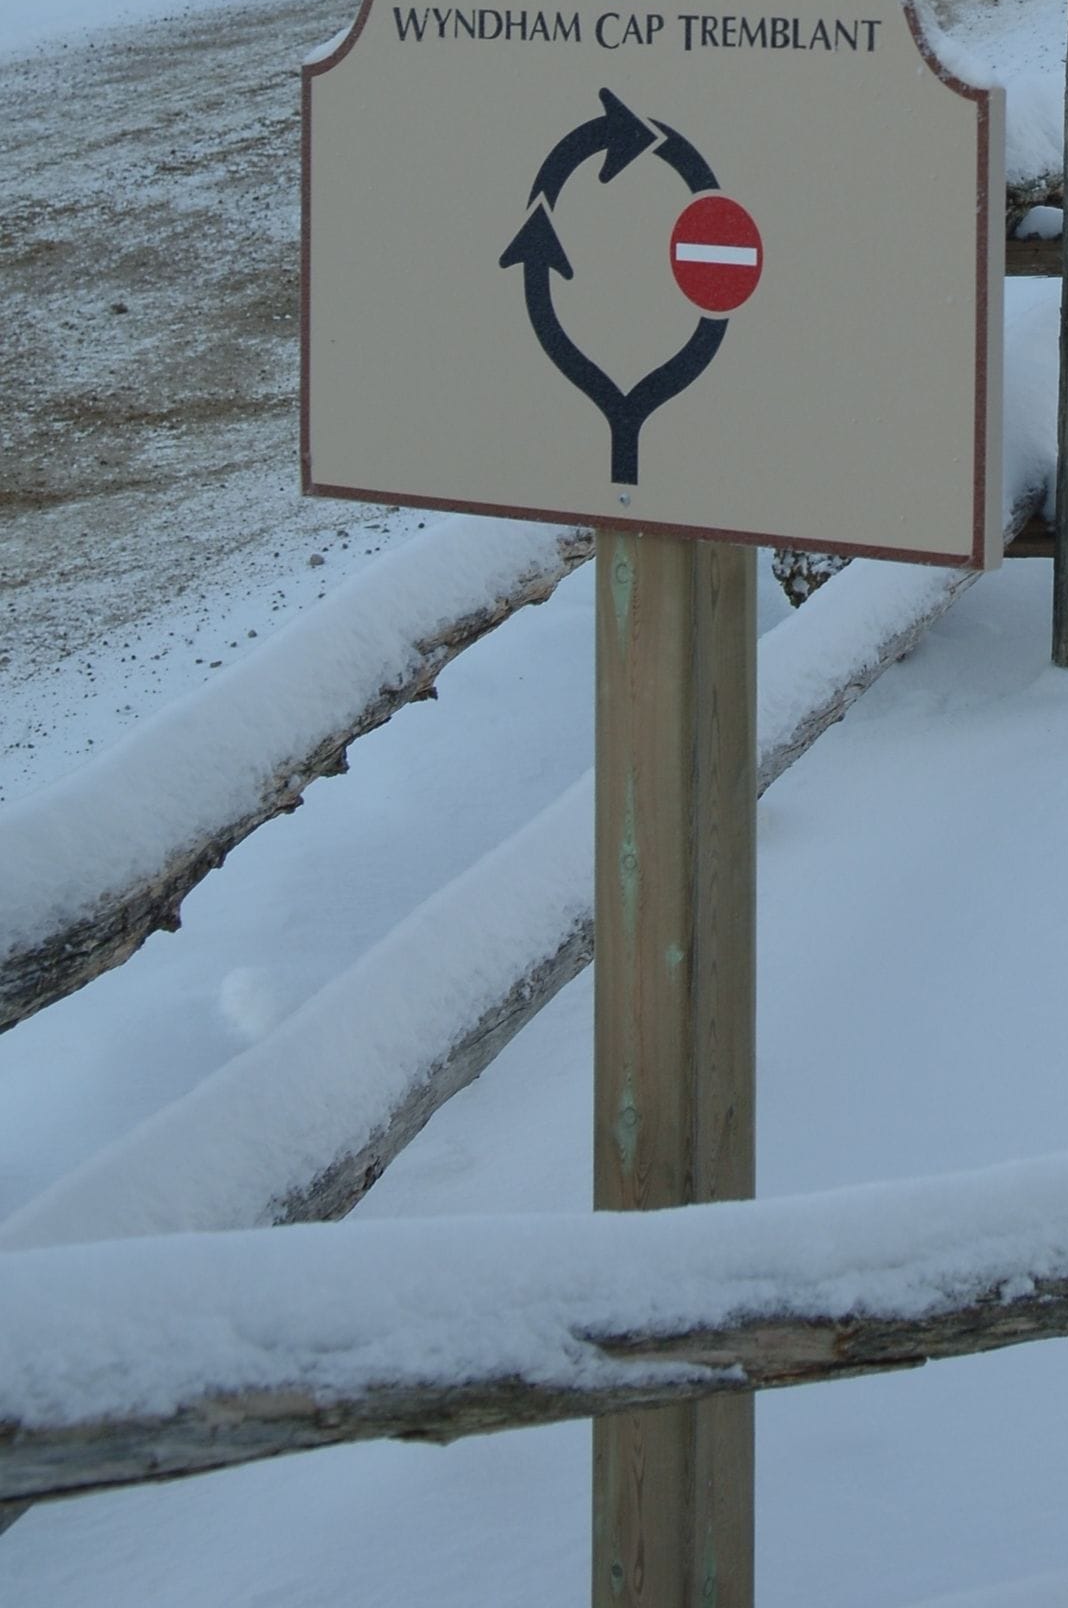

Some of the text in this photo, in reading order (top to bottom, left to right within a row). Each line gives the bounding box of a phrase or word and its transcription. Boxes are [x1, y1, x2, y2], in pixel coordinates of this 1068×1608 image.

[393, 6, 882, 52] WYNDHAM CAP TREMBLANT
